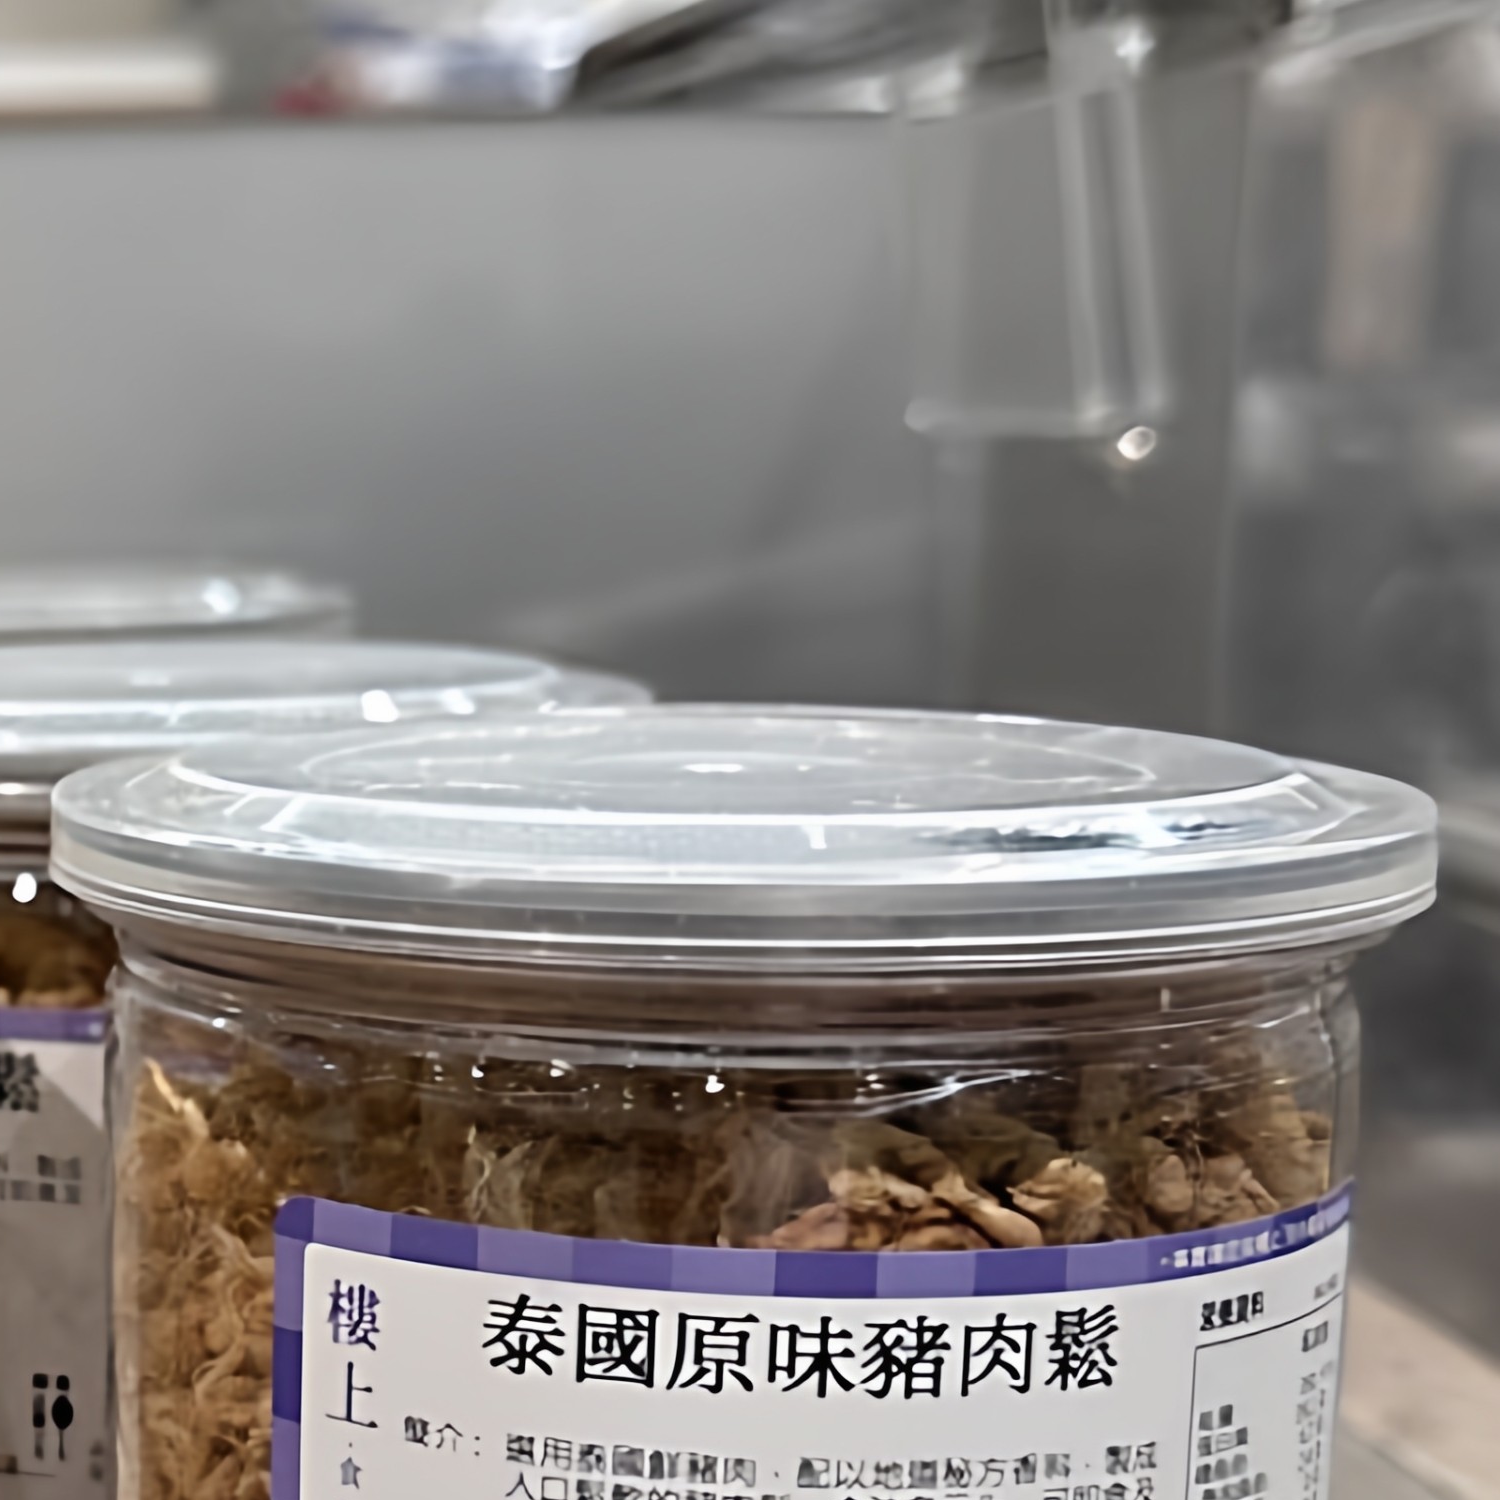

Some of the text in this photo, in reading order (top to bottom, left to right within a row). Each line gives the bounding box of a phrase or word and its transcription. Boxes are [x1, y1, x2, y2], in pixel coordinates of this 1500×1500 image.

[325, 1279, 381, 1429] 樓上
[482, 1293, 1120, 1400] 泰國原味豬肉鬆
